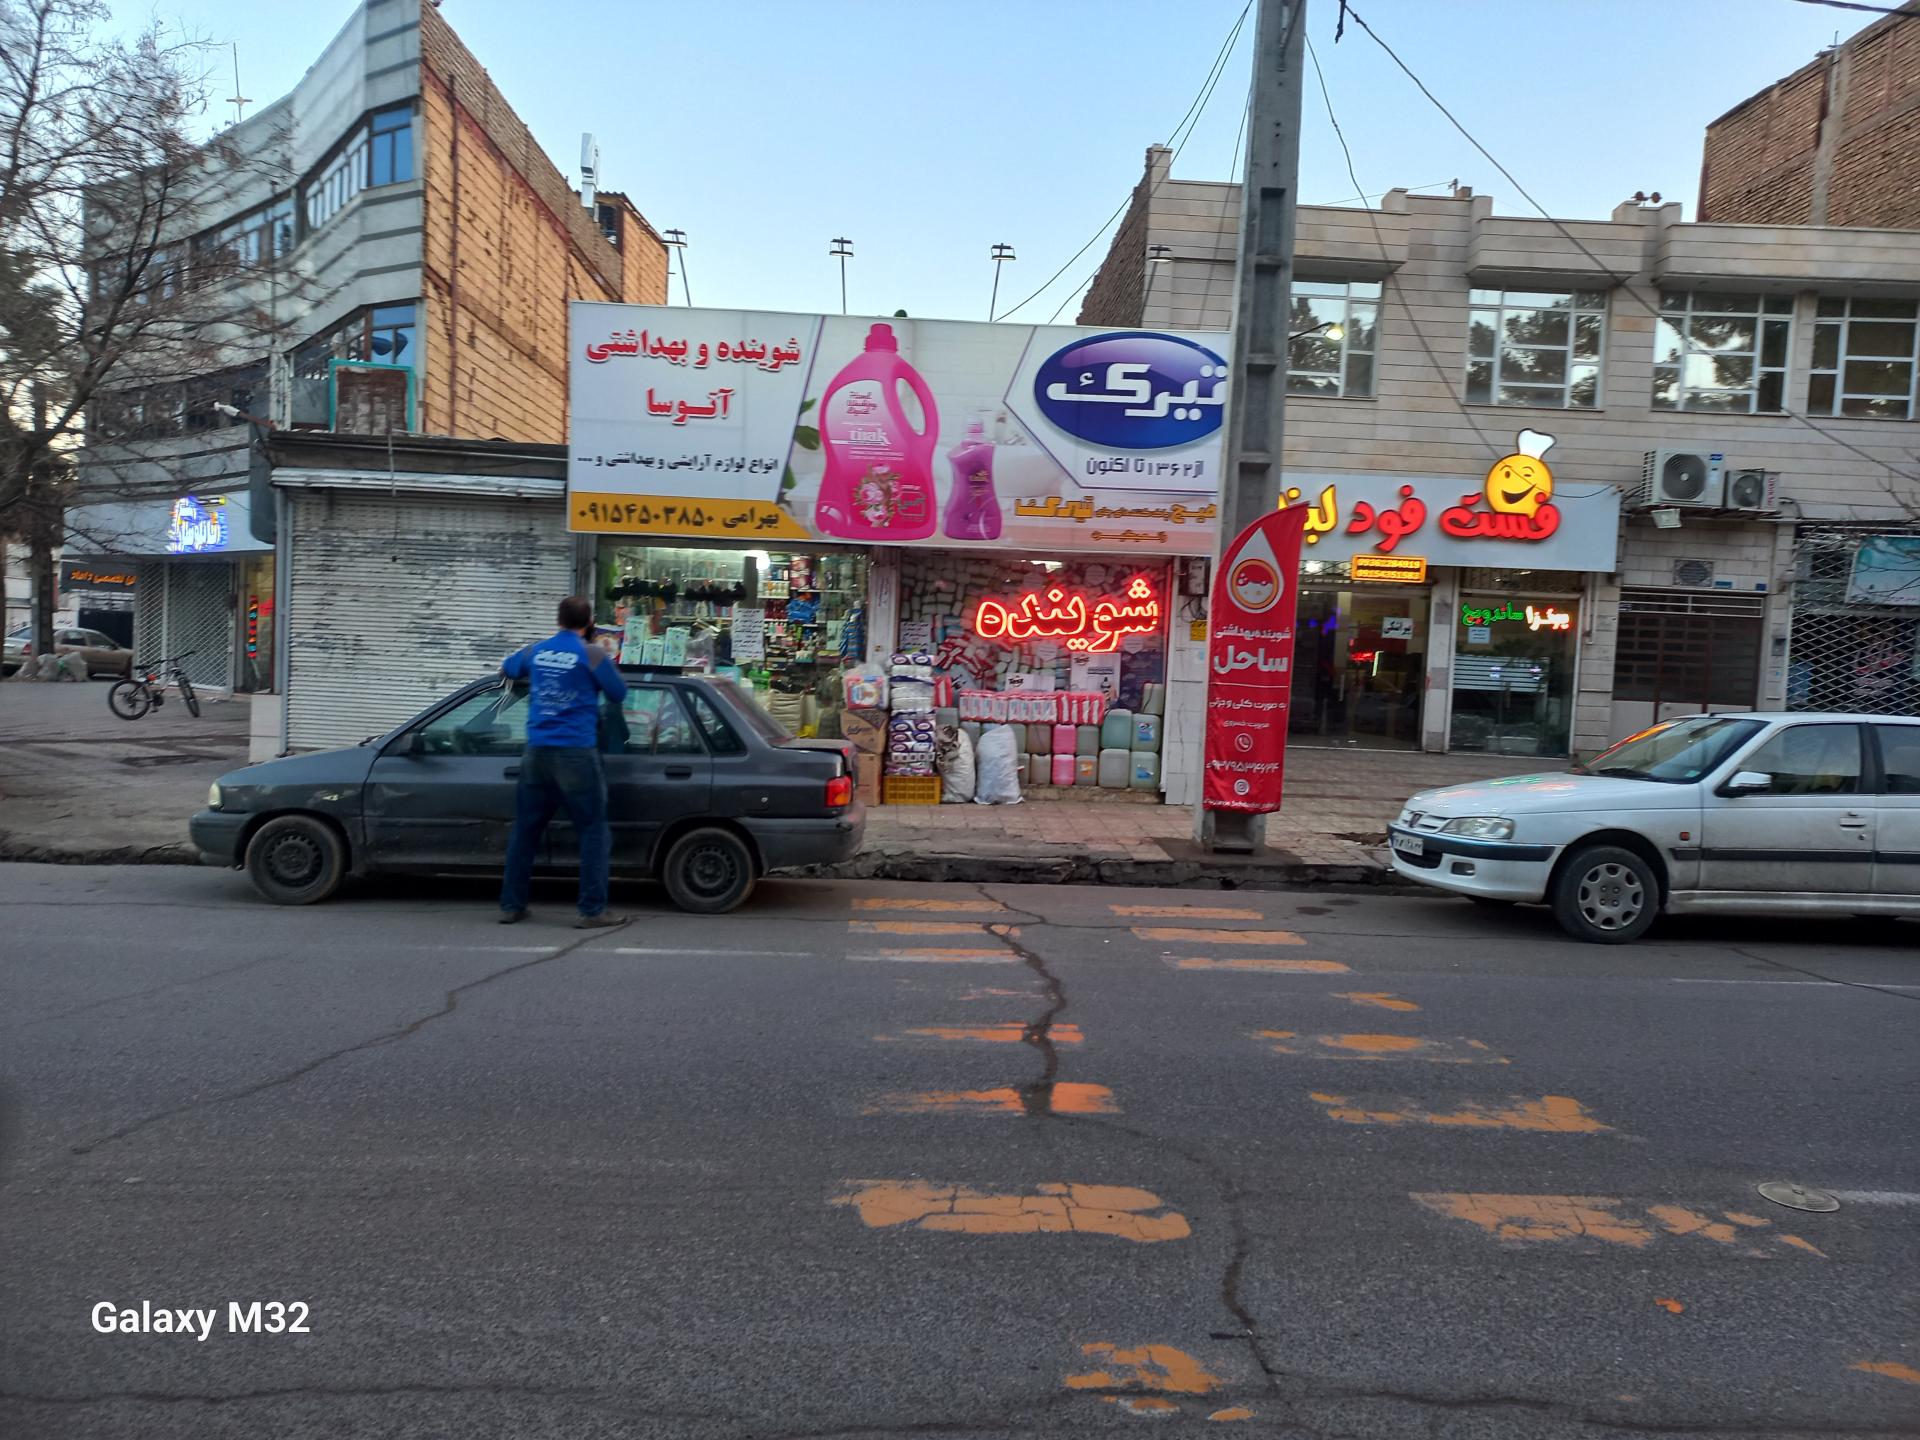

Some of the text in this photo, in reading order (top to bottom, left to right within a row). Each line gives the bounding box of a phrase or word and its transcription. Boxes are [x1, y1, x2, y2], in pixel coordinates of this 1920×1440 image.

[585, 328, 801, 372] شوینده و بهداشتی
[594, 455, 603, 467] و
[605, 451, 655, 468] بهداشتی
[656, 458, 665, 470] و
[666, 452, 713, 472] آرایشی
[714, 456, 746, 473] لوازم
[748, 458, 778, 475] انواع
[1086, 457, 1131, 475] اکنون
[1134, 458, 1146, 474] تا
[1193, 459, 1205, 478] از
[1344, 484, 1427, 553] فود
[1438, 491, 1562, 543] فست
[976, 577, 1159, 653] شوینده
[1462, 601, 1570, 631] پیتزا ساندویچ
[1213, 645, 1289, 675] ساحل
